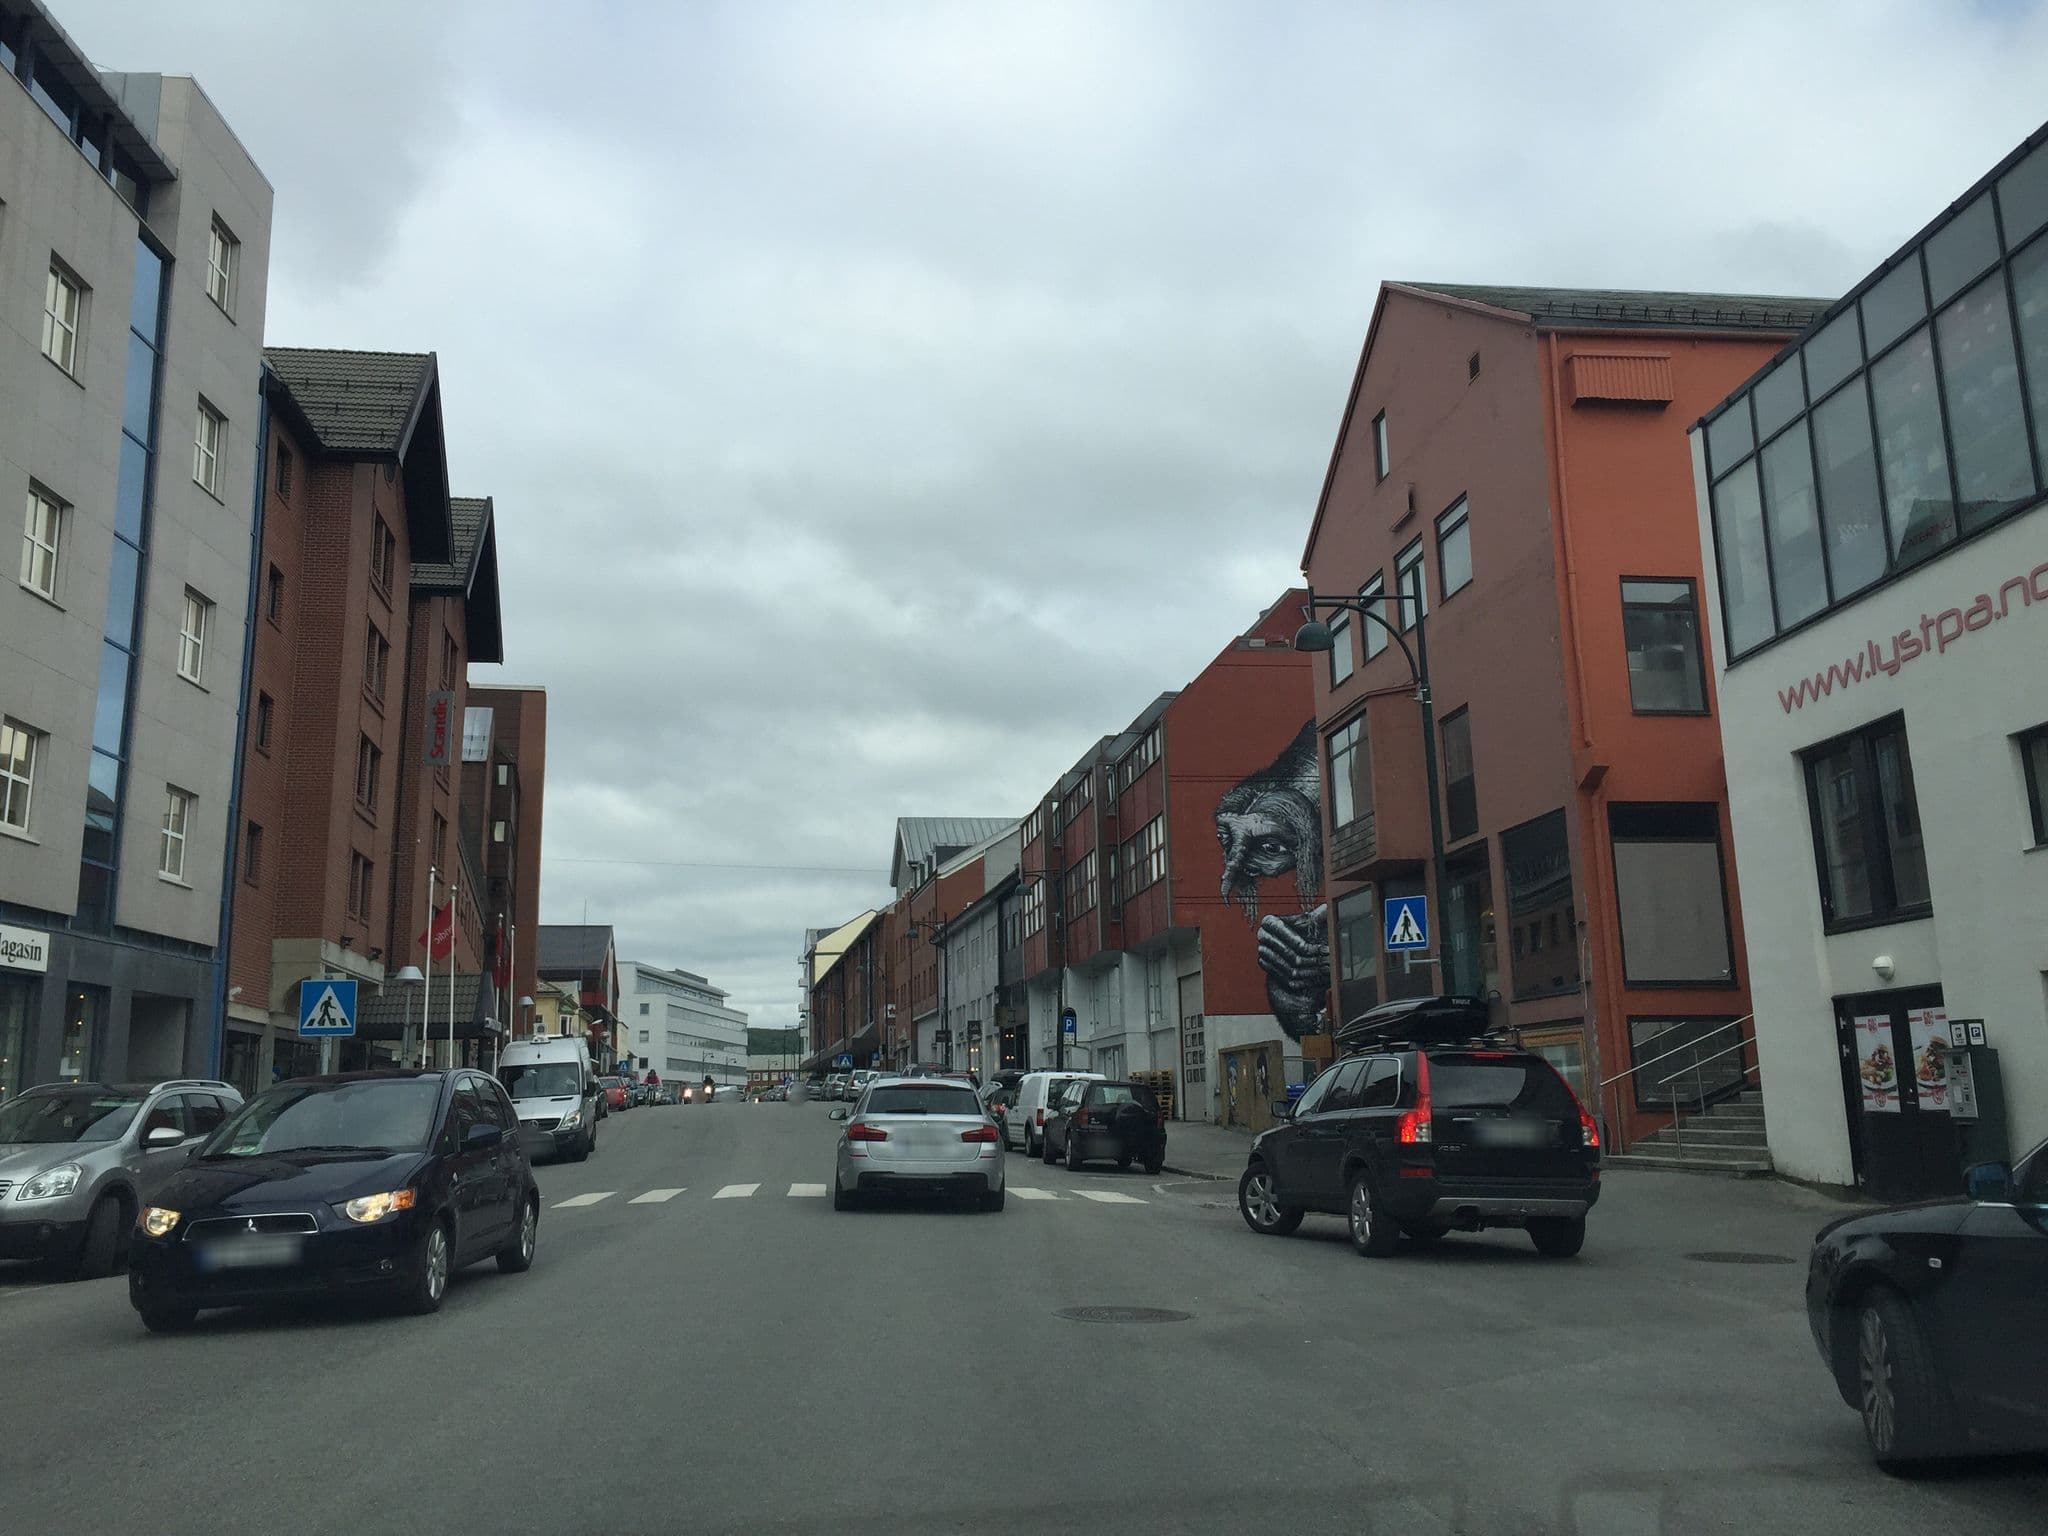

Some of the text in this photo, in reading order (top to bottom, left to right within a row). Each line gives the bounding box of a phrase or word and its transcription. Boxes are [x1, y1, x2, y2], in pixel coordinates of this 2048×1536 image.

[0, 933, 42, 963] agasin
[1065, 1019, 1073, 1031] P
[1972, 1028, 1980, 1037] P
